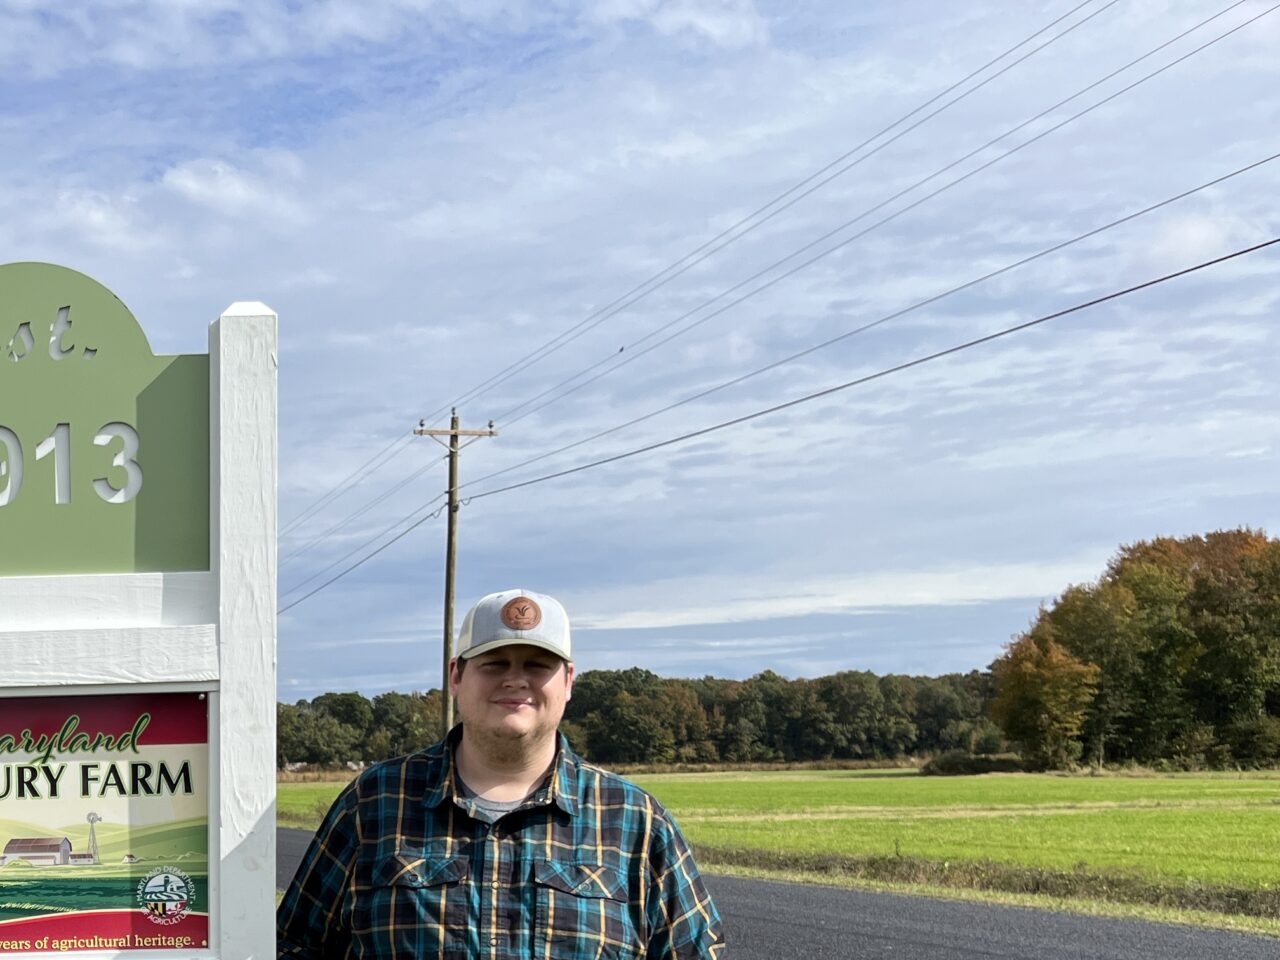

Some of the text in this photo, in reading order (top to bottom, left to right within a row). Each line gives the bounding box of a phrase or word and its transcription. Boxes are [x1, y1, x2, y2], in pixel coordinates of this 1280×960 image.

[80, 761, 194, 798] FARM
[137, 866, 196, 901] MARYLAND DEPARTMENT
[147, 906, 192, 925] AGRICULTUE
[35, 936, 49, 950] of
[51, 935, 131, 951] agricultural
[134, 934, 196, 949] heritage.
